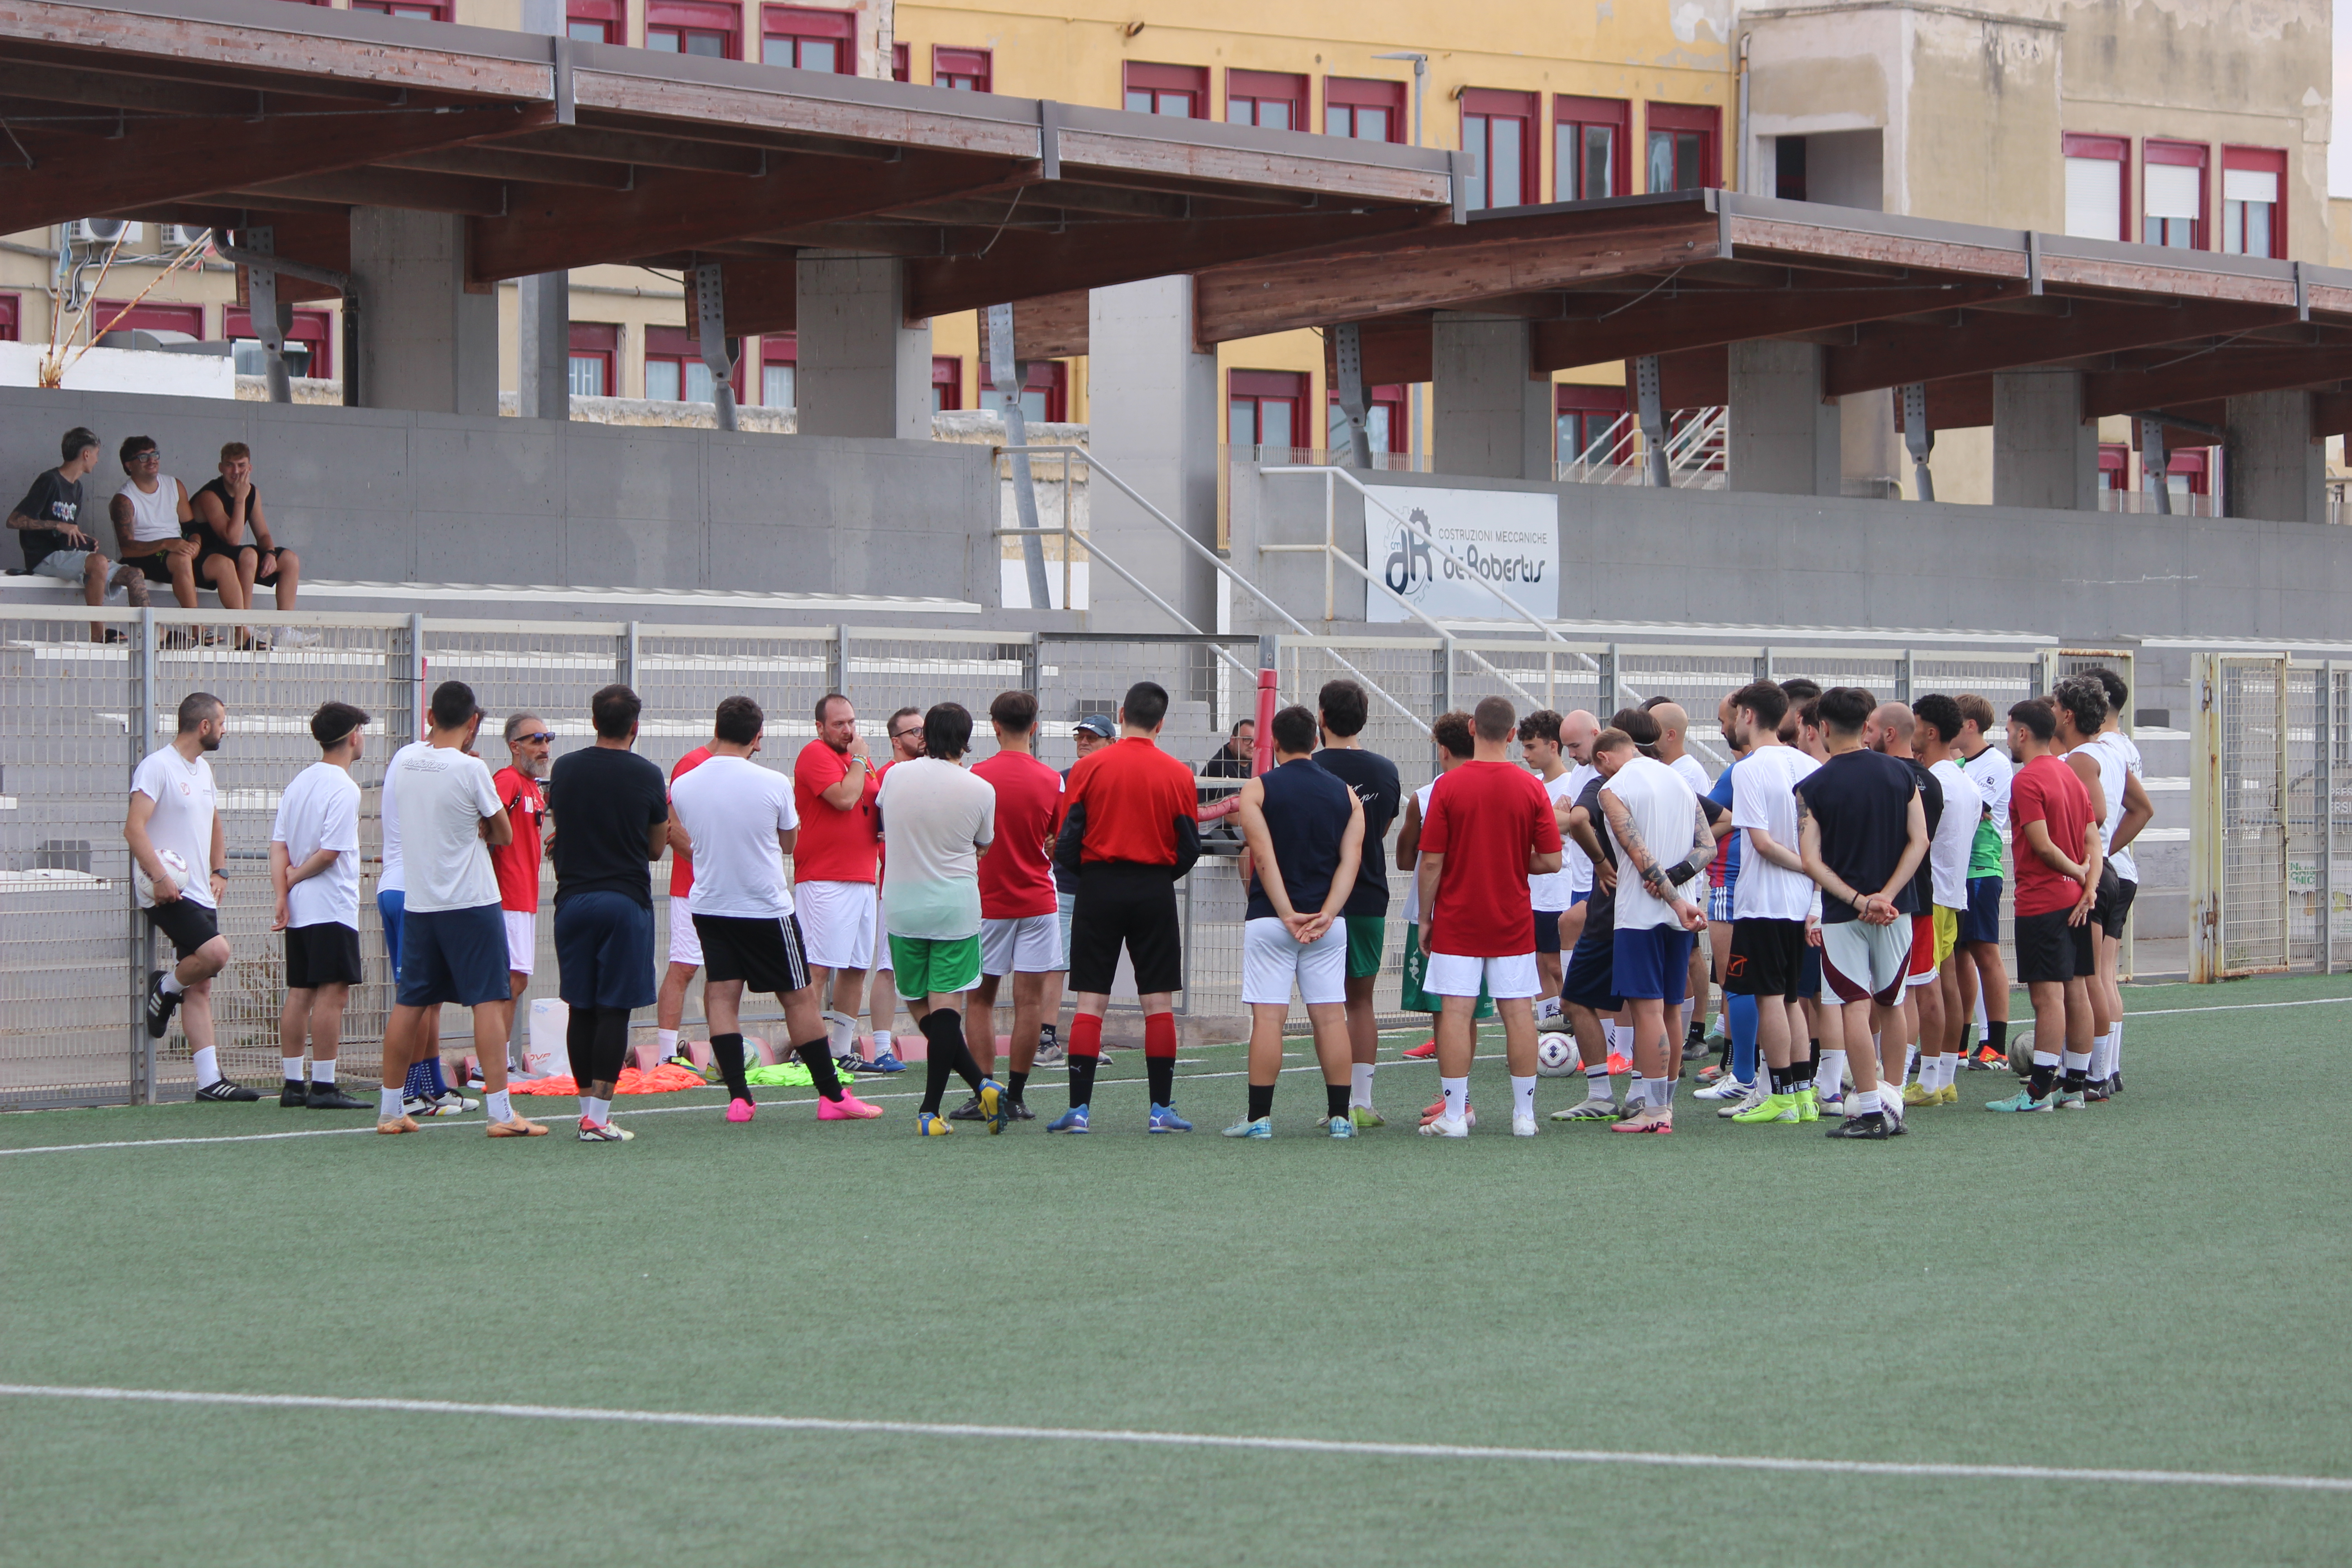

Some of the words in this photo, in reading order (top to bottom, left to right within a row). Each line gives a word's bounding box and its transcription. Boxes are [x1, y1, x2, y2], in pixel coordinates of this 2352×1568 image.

[1438, 528, 1493, 541] COSTRUZIONI
[1495, 530, 1547, 544] MECCANICHE
[1786, 757, 1797, 785] UNDE
[1977, 780, 1997, 793] Expedia
